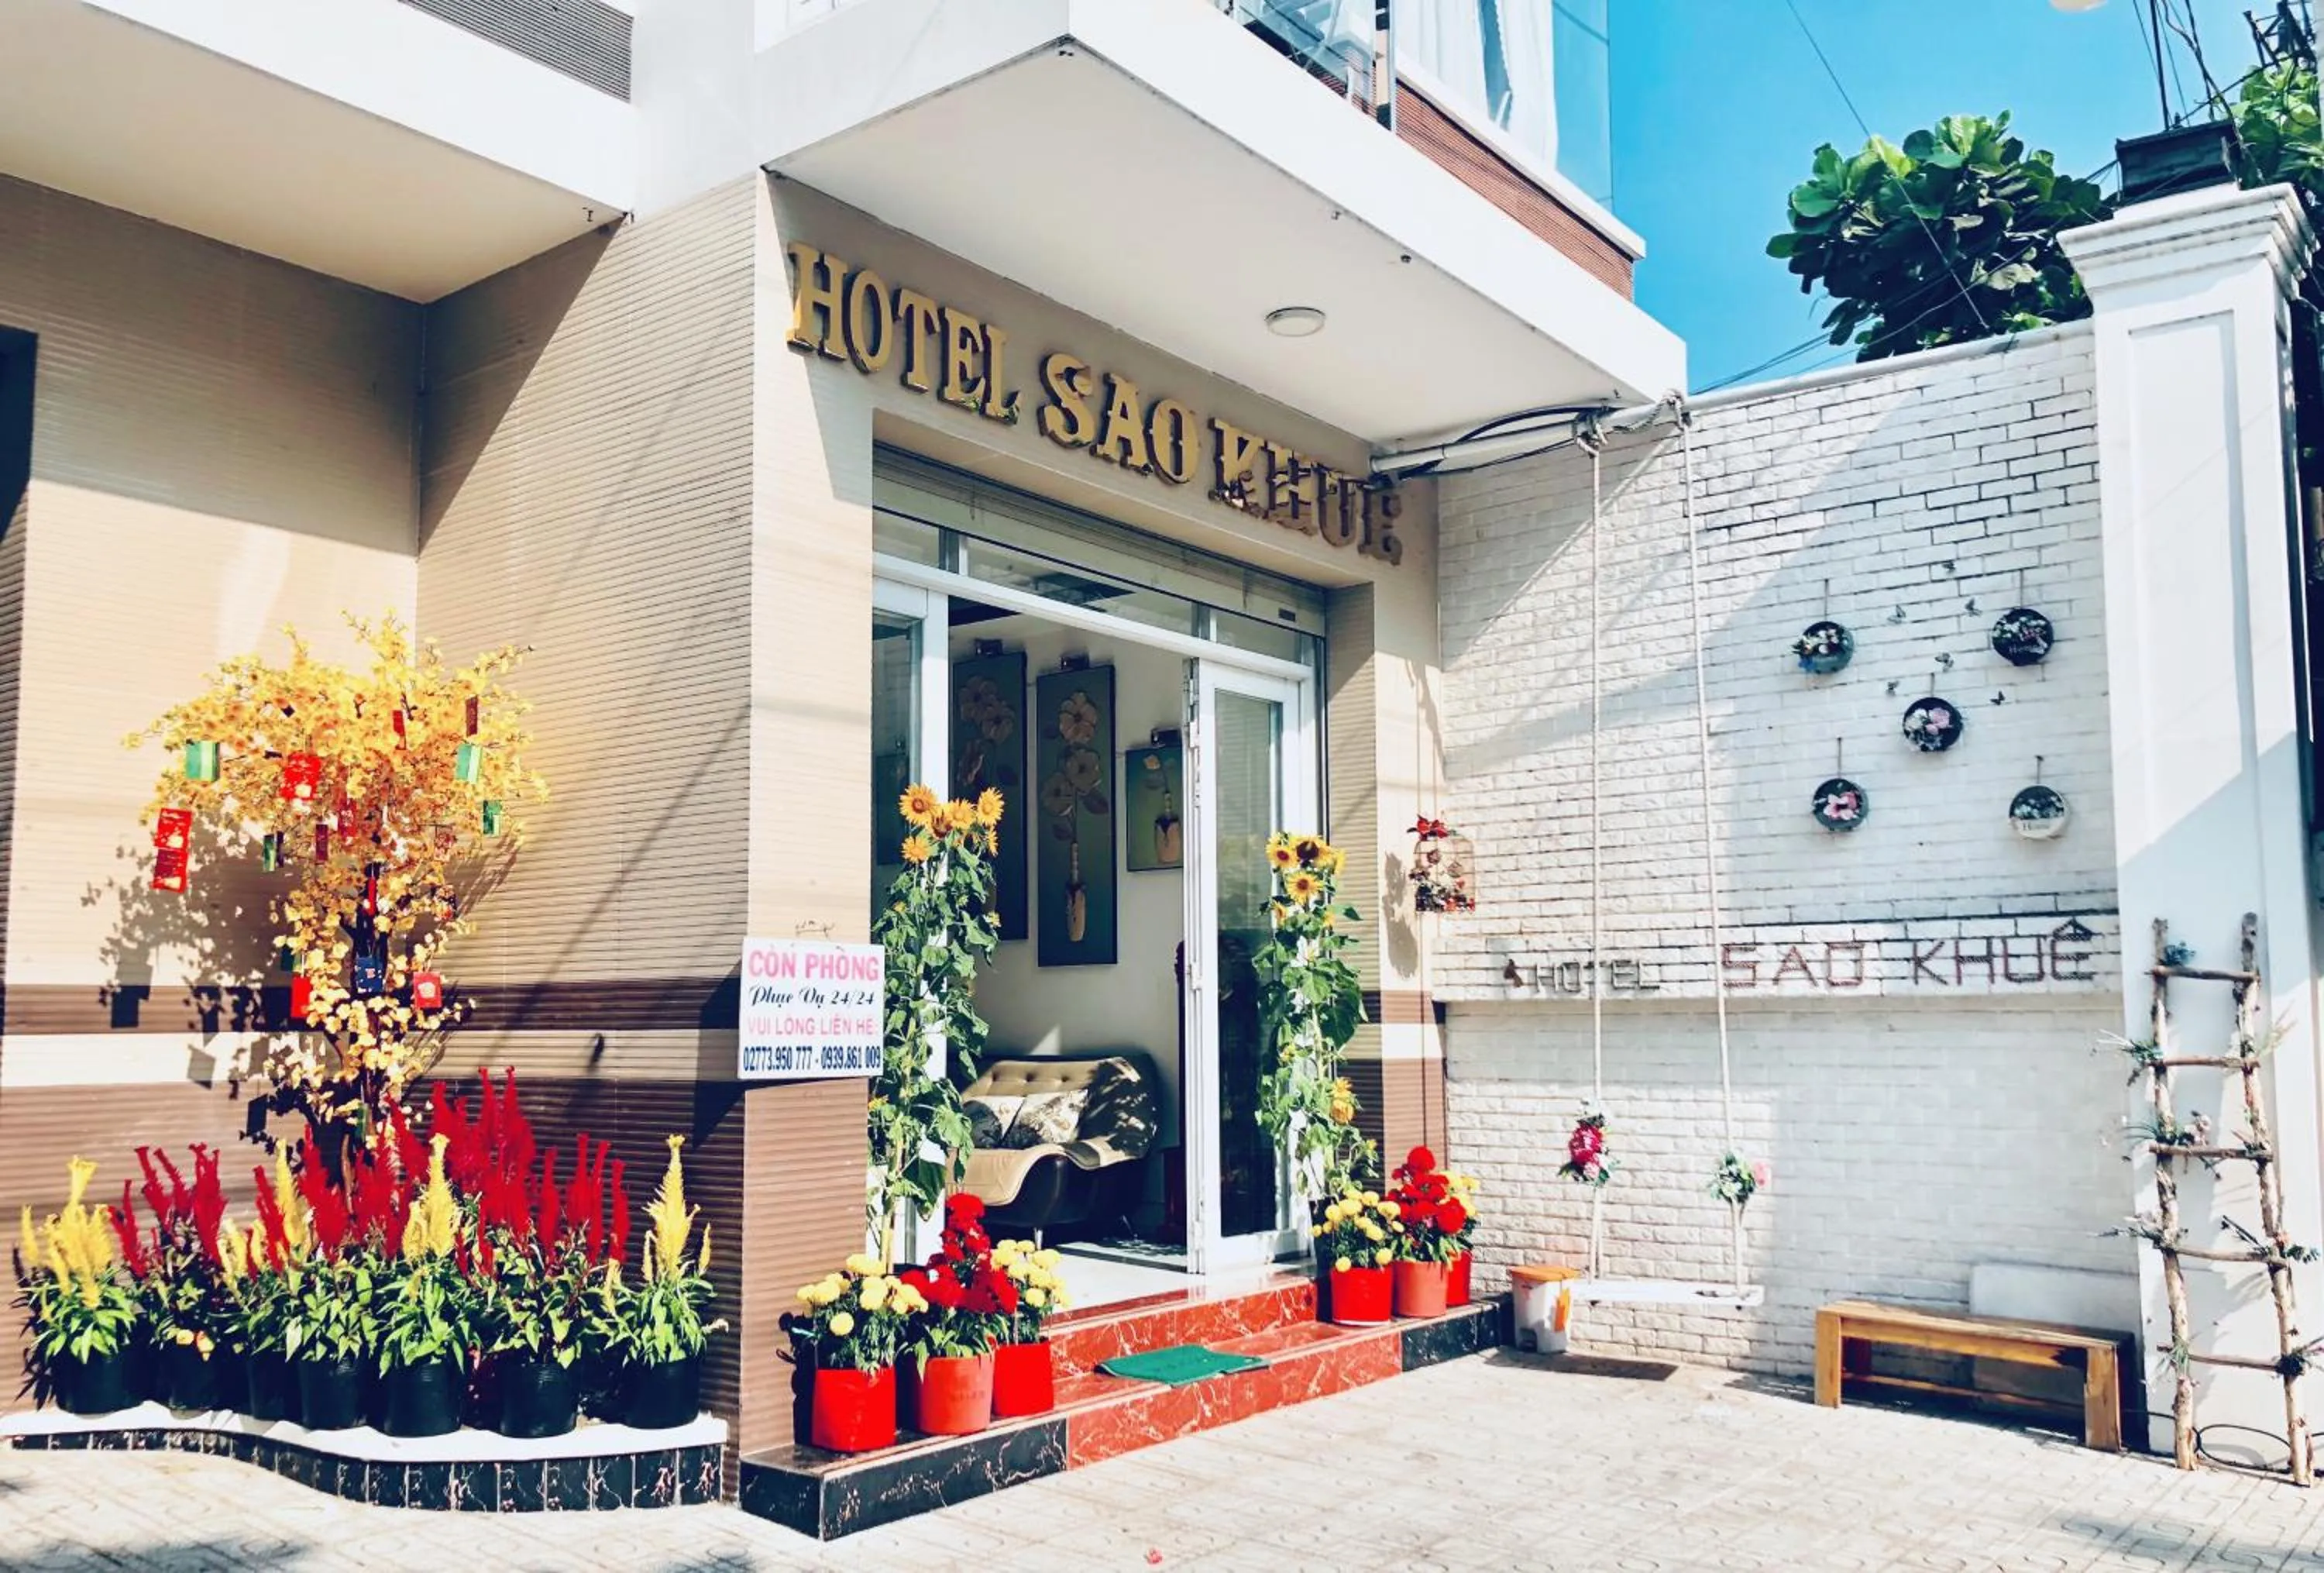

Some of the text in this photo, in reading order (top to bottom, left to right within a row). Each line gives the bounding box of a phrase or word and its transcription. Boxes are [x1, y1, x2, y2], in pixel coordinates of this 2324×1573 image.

[785, 242, 1023, 426] HOTEL
[1037, 353, 1200, 485] SAO
[1721, 942, 1865, 988] SAO
[1913, 916, 2094, 986] KHUÊ
[748, 1017, 771, 1035] VUI
